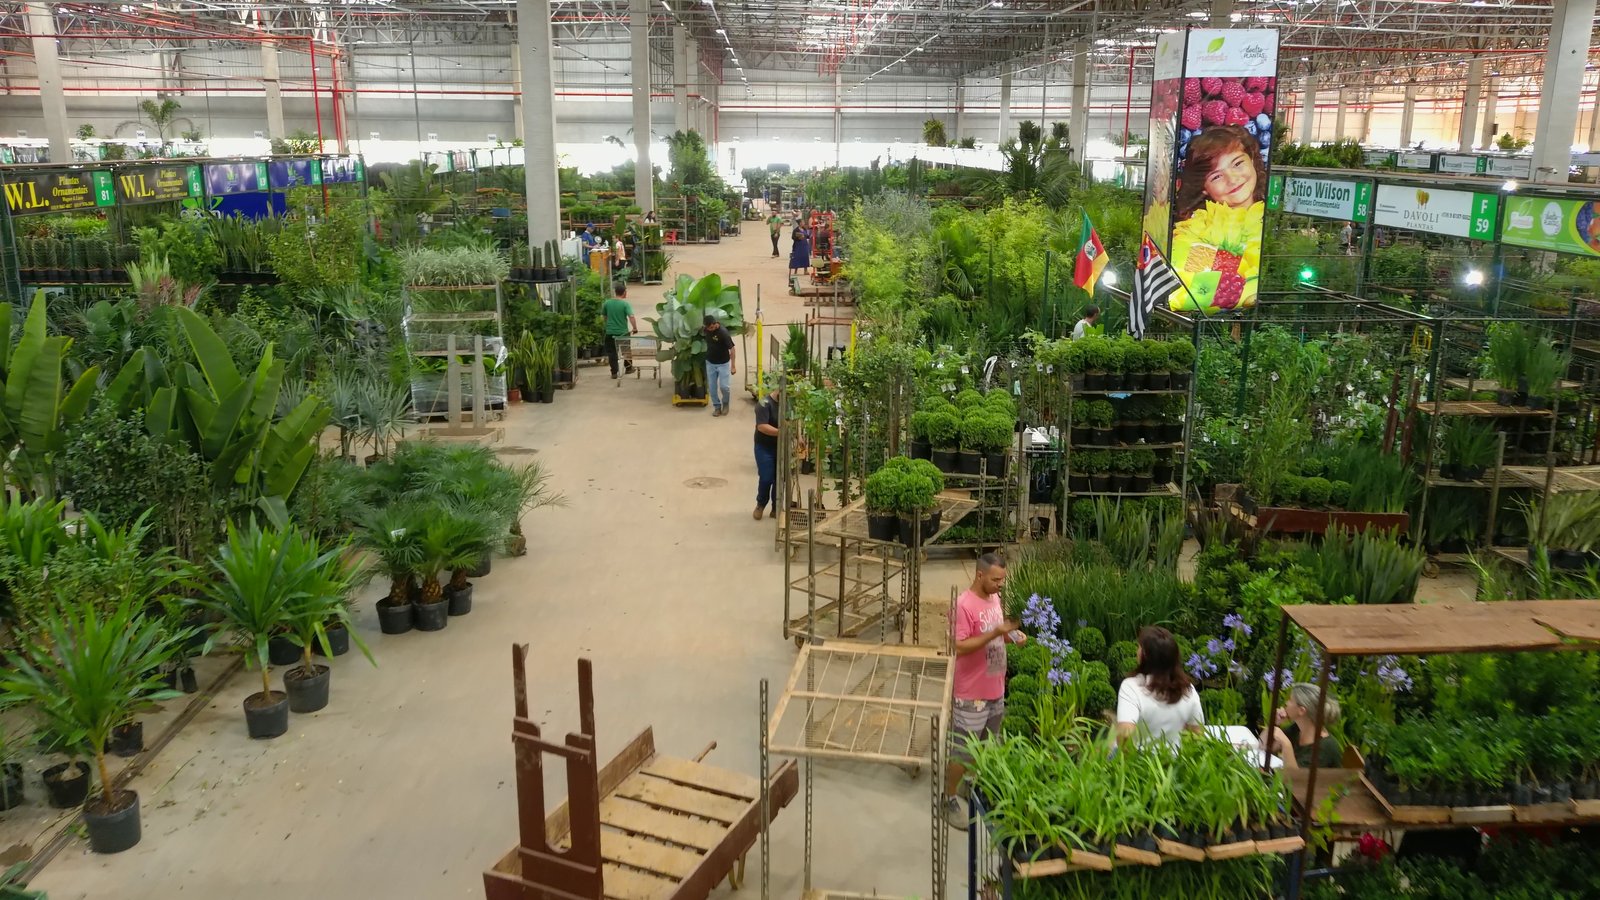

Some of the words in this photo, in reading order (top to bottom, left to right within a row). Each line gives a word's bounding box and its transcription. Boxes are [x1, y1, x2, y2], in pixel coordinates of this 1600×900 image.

[52, 184, 88, 197] Ornamentais
[120, 174, 154, 199] W.L.
[193, 182, 200, 192] 82
[1315, 182, 1351, 201] Wilson
[4, 182, 49, 211] W.L.
[101, 190, 110, 200] 81
[1271, 195, 1280, 205] 57
[1361, 188, 1366, 200] F
[1297, 198, 1312, 206] Plantas
[1313, 200, 1340, 209] Ornamentais
[1481, 200, 1488, 213] F
[1356, 204, 1367, 216] 58
[1404, 210, 1440, 223] DAVOLI
[1407, 222, 1434, 230] PLANTAS
[1476, 218, 1489, 233] 59
